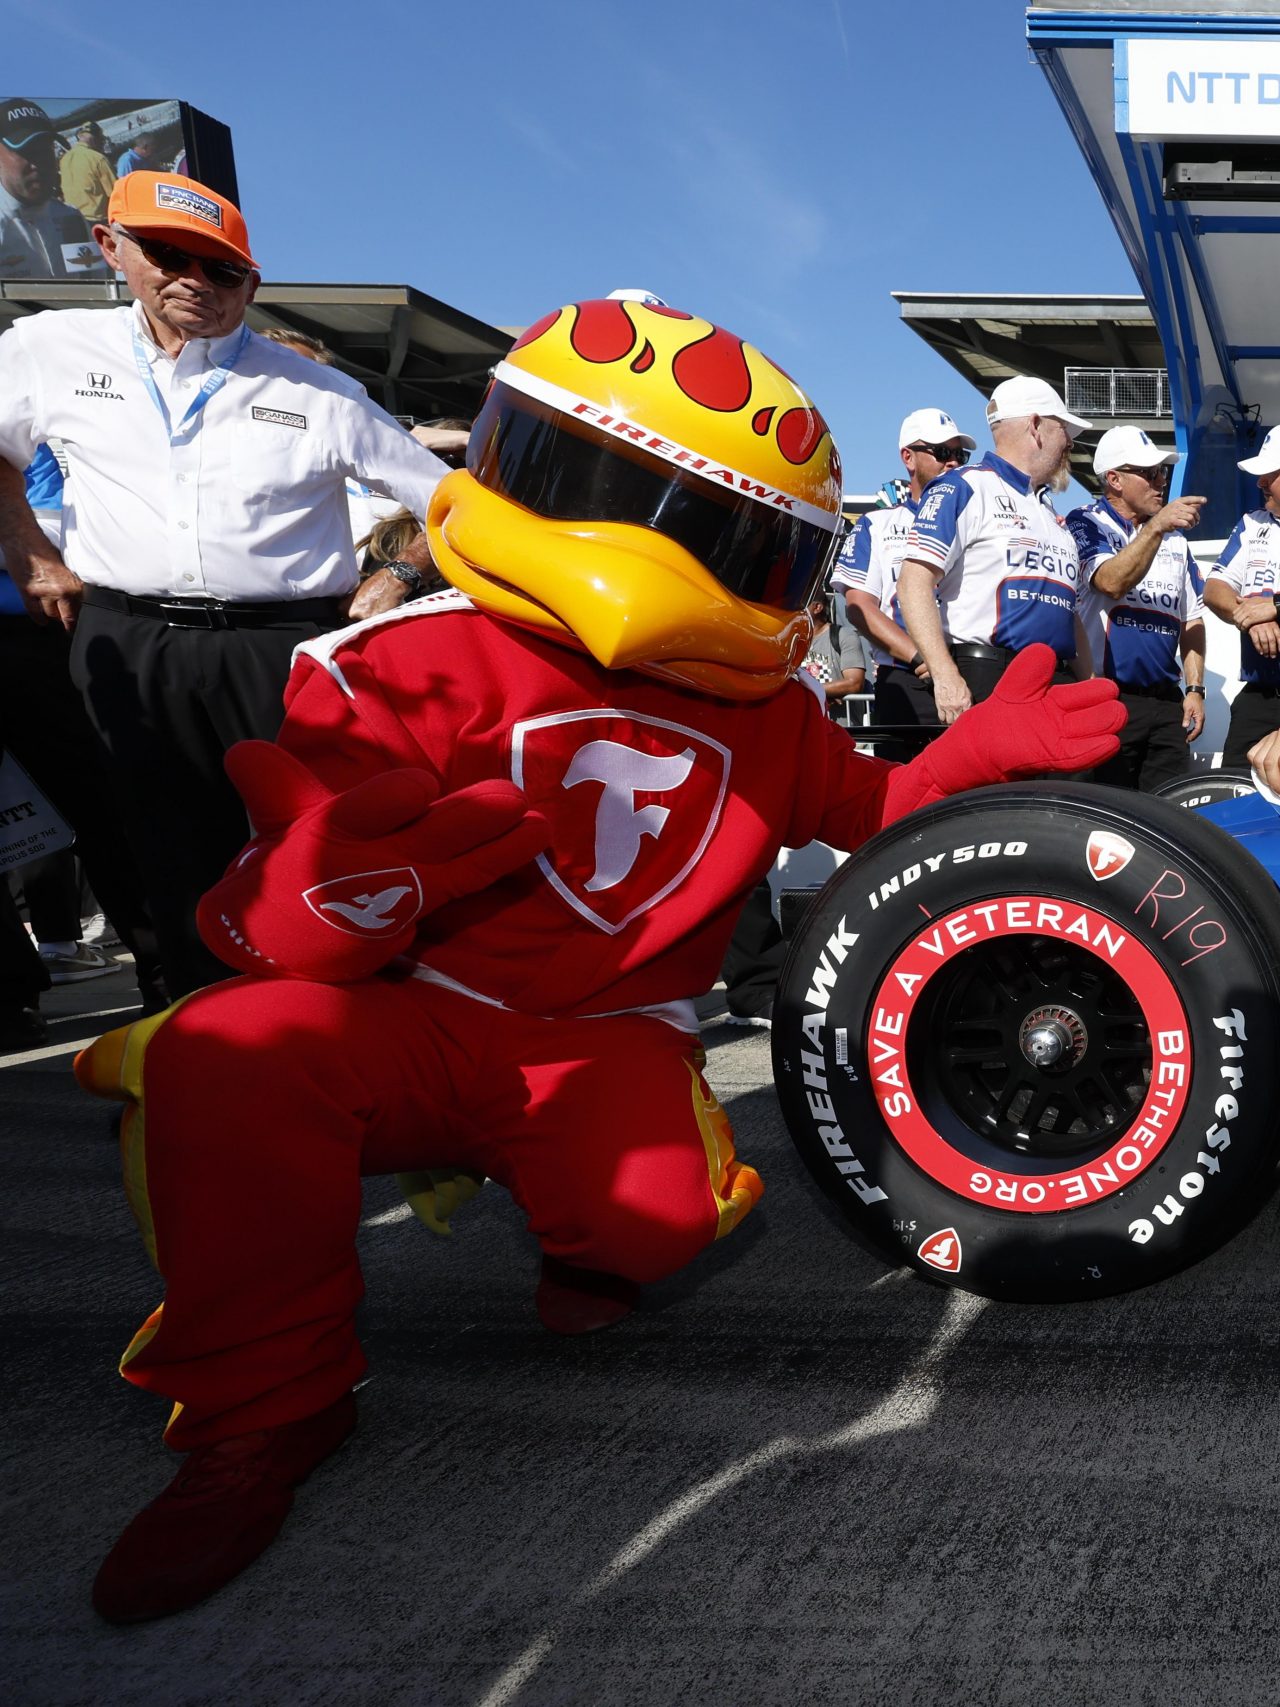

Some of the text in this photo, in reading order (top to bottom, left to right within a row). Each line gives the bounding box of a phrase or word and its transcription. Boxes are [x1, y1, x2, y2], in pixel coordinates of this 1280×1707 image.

[1167, 71, 1249, 104] NTT
[75, 390, 125, 401] HONDA
[572, 403, 799, 511] FIREHAWK
[1006, 549, 1076, 581] LEGIO
[1037, 542, 1077, 562] AMERIC
[868, 841, 1028, 910] INDY 500
[1134, 869, 1227, 966] R19
[875, 901, 1126, 1118] SAVE A VETERAN
[801, 914, 889, 1206] FIREHAWK
[969, 1030, 1184, 1205] BETHEONE.ORG
[1128, 1008, 1246, 1245] Firestone
